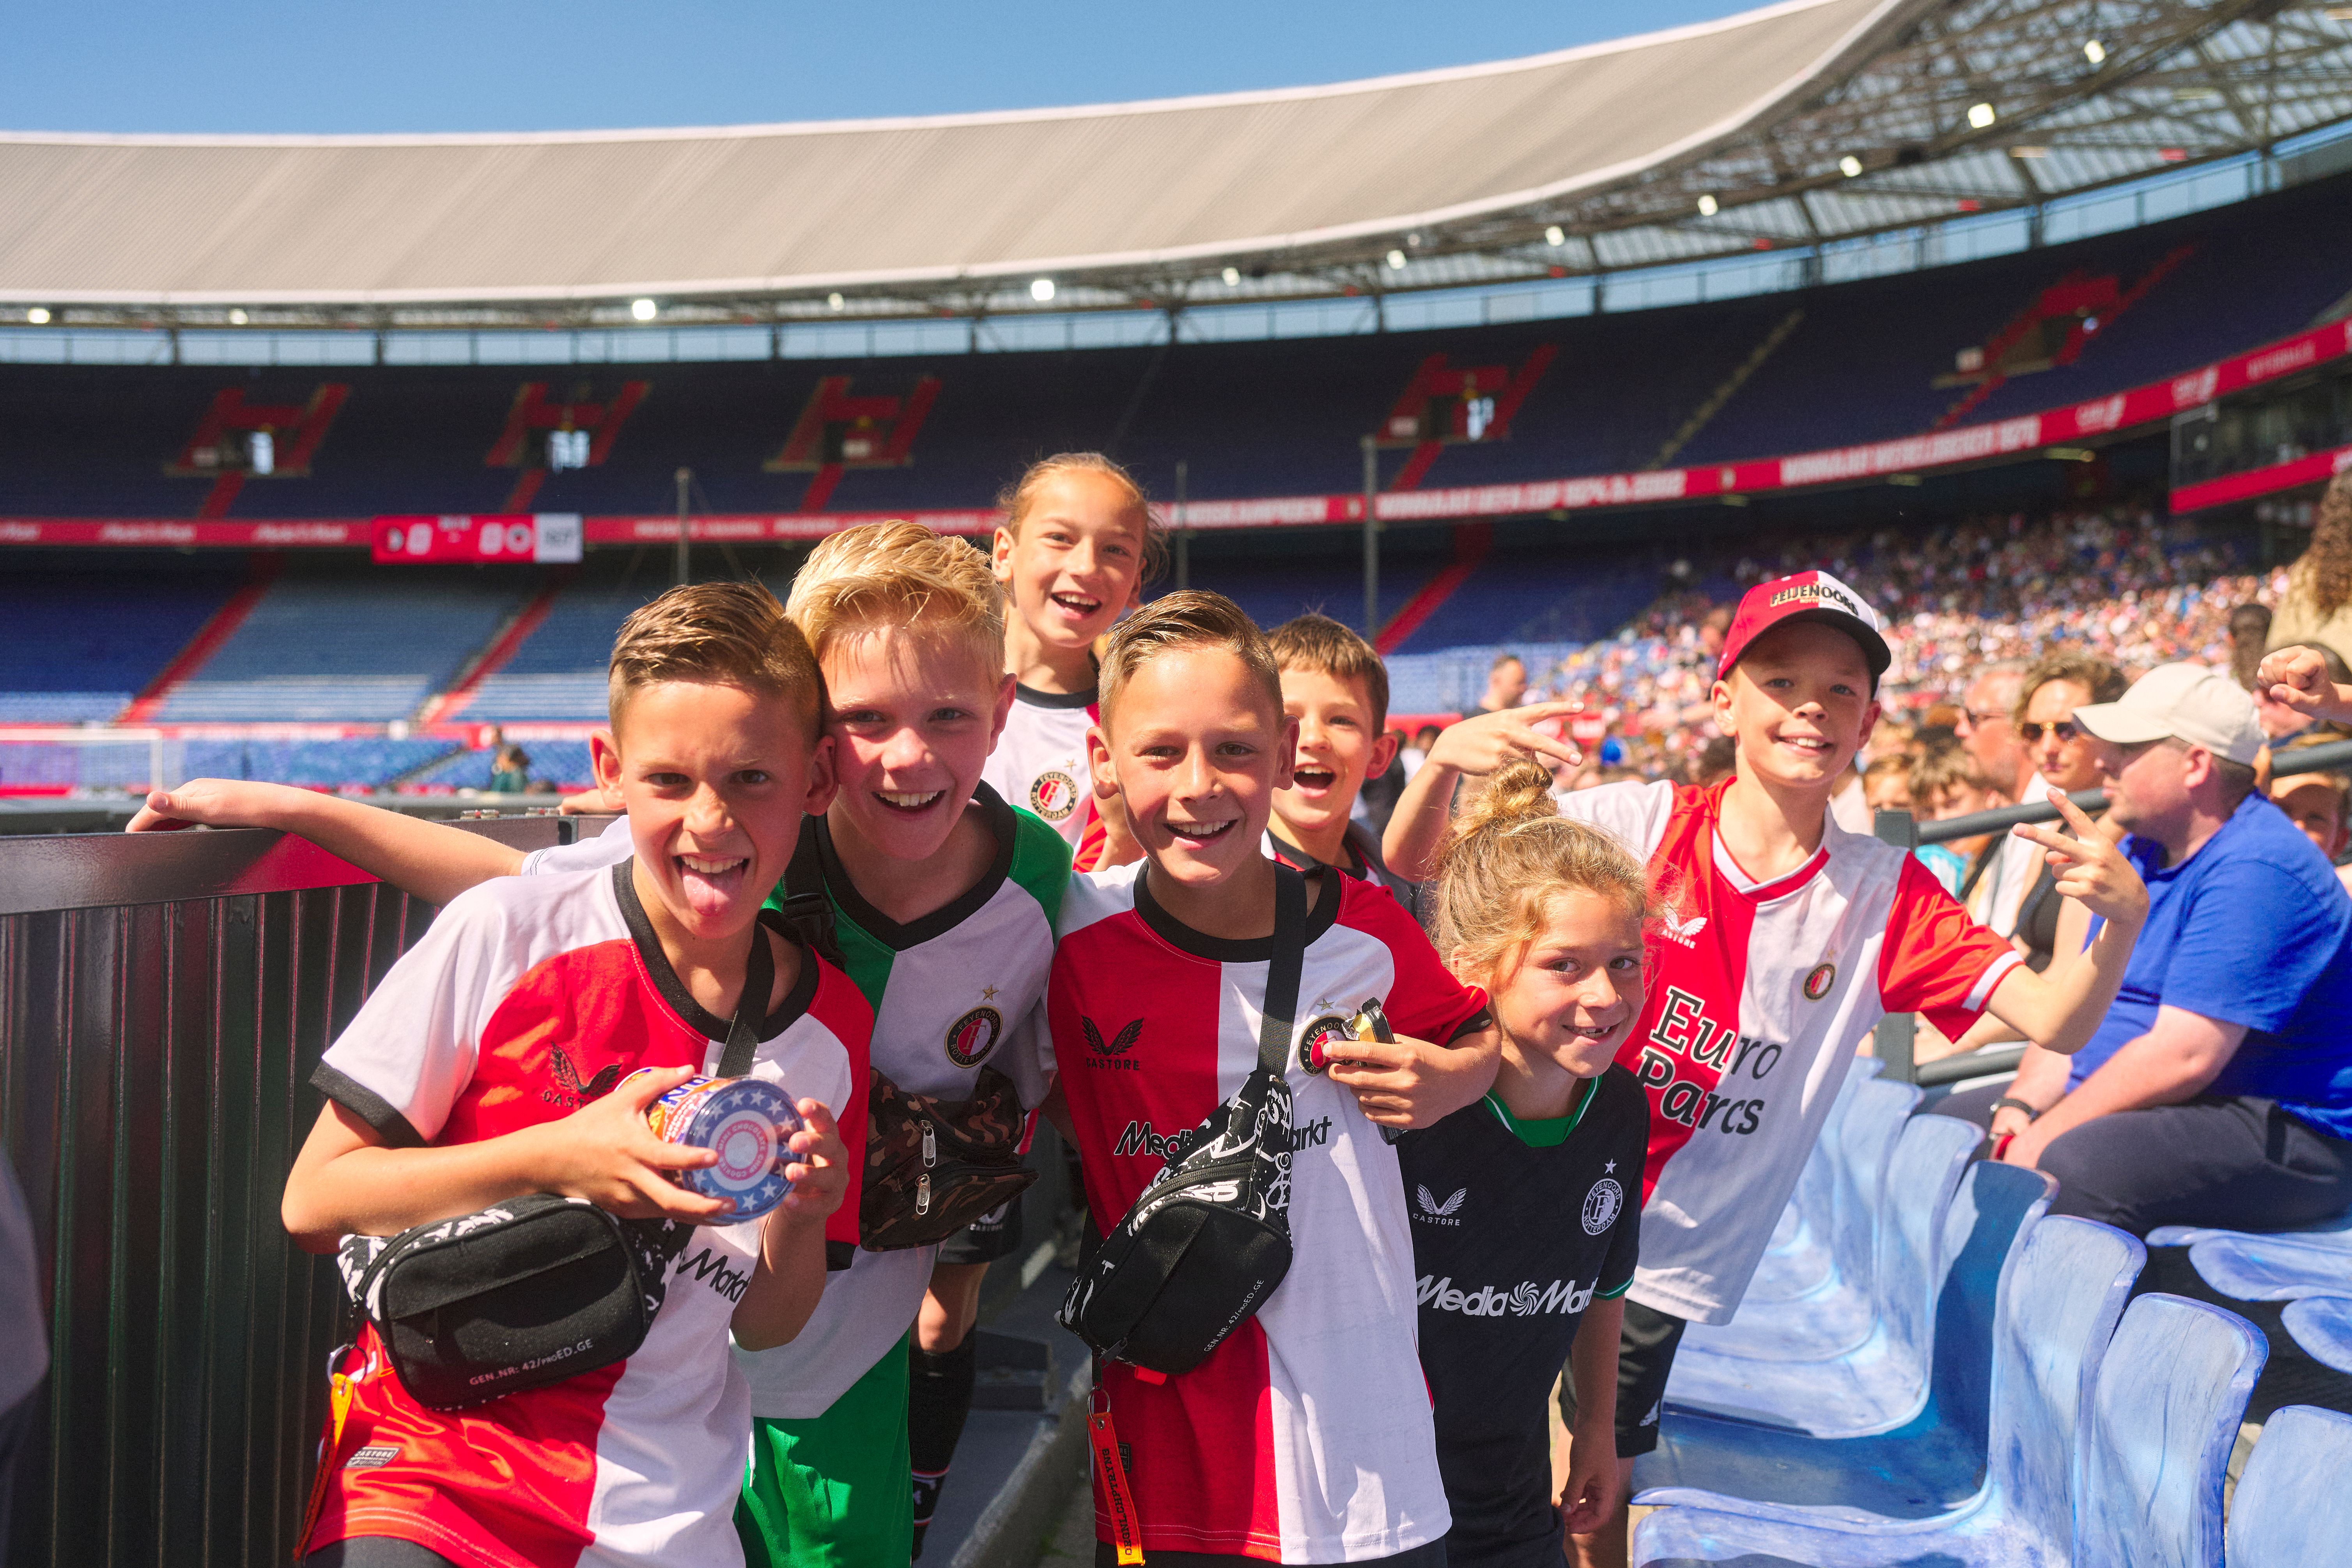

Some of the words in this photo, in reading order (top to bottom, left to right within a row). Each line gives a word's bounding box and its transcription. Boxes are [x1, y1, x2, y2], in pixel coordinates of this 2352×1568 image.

[1661, 929, 1696, 949] ASTORE
[958, 1011, 998, 1029] FEYENOORD
[963, 1025, 987, 1050] F
[1304, 1022, 1342, 1051] FEYENOO
[1649, 985, 1782, 1080] Euro
[951, 1043, 991, 1063] ROTTERDAM
[544, 1091, 586, 1110] CAST
[1636, 1046, 1765, 1135] Parcs
[1114, 1120, 1192, 1160] Med
[1293, 1115, 1333, 1152] arkt
[1589, 1181, 1621, 1201] FEYENOORD
[1591, 1195, 1611, 1220] F
[1412, 1213, 1460, 1226] CASTORE
[1583, 1213, 1616, 1233] ROTTERDAM
[1416, 1274, 1509, 1317] Media
